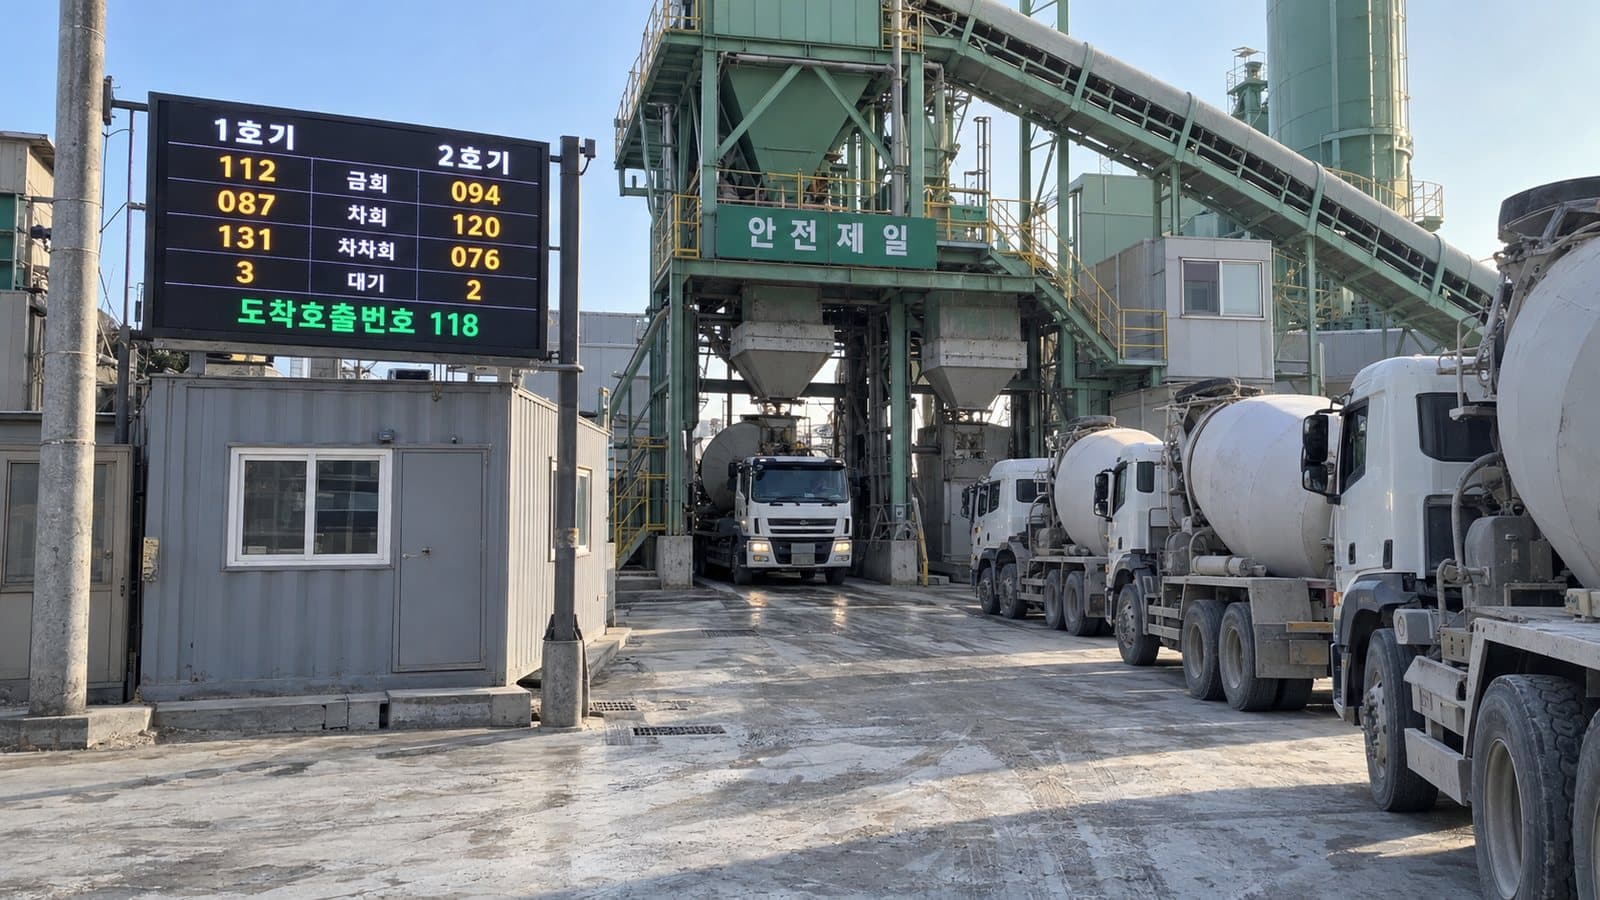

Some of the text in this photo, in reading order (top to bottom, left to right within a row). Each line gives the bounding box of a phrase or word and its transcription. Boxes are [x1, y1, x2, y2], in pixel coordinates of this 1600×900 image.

[214, 118, 294, 151] 1호기
[219, 155, 276, 183] 112
[438, 144, 509, 175] 2호기
[346, 171, 388, 193] 금회
[451, 181, 501, 206] 094
[217, 190, 276, 217] 087
[347, 205, 387, 228] 차회
[452, 214, 501, 238] 120
[218, 225, 271, 251] 131
[748, 216, 908, 257] 안전제일
[338, 238, 395, 261] 차차회
[450, 246, 500, 271] 076
[235, 261, 254, 284] 3
[347, 273, 384, 293] 대기
[466, 280, 481, 301] 2
[237, 298, 479, 338] 도착호출번호 118
